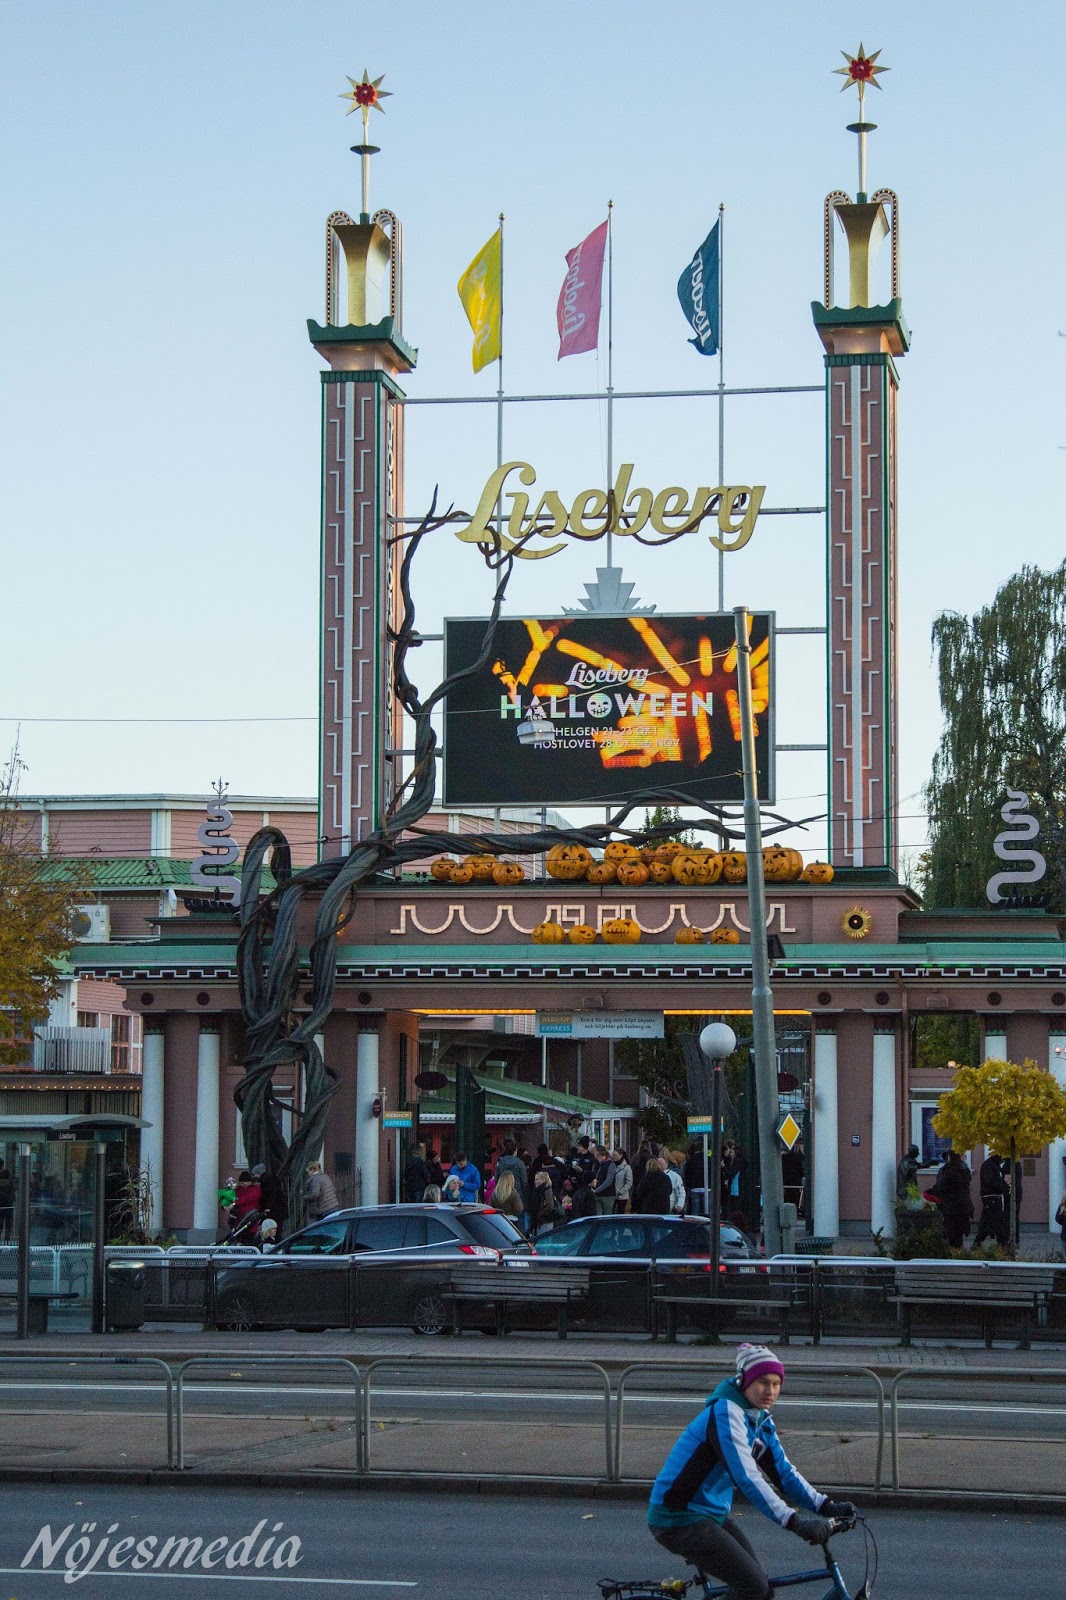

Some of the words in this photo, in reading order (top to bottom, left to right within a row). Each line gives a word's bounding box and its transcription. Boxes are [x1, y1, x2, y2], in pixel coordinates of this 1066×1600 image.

[454, 461, 767, 560] Liseberg
[565, 662, 649, 690] Liseberg
[500, 691, 713, 719] HALLOWEEN
